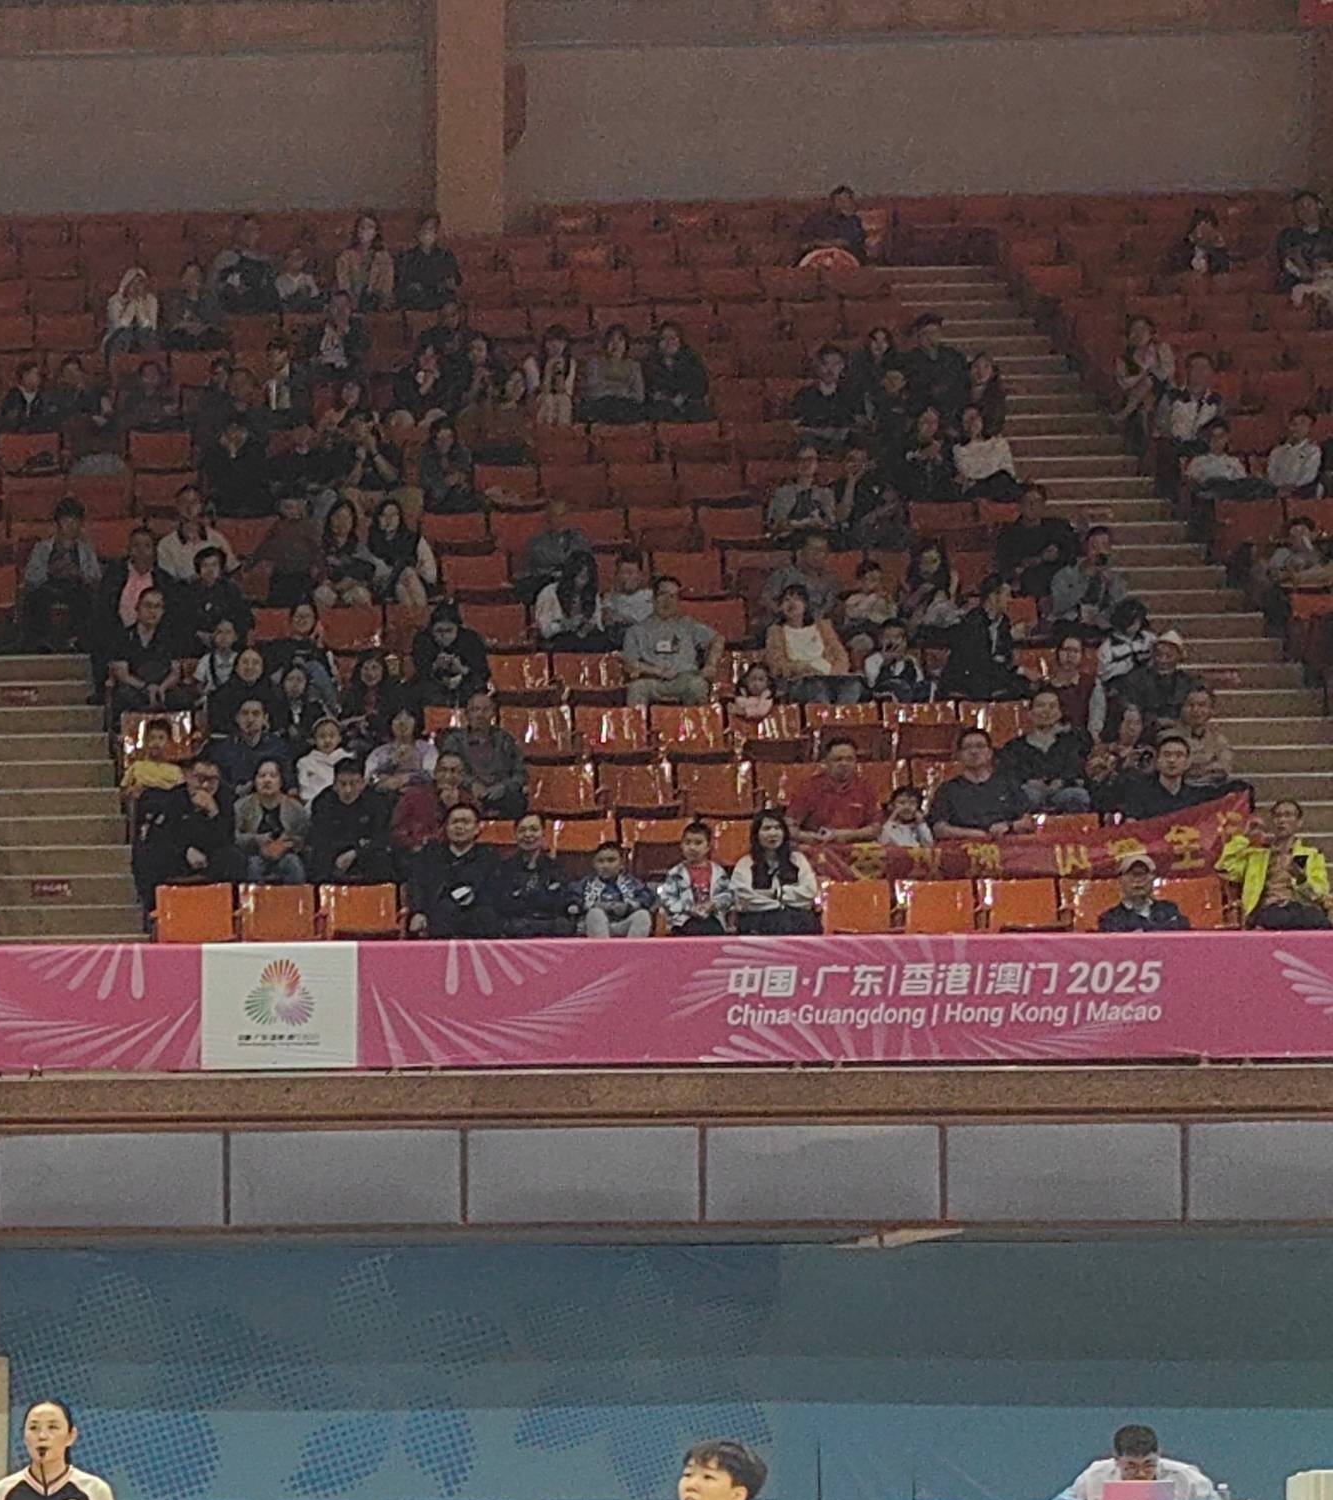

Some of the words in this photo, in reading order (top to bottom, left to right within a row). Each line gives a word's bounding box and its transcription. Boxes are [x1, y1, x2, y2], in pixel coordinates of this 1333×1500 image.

[1066, 960, 1163, 994] 2025
[944, 1002, 1003, 1027] Hong
[1010, 1001, 1068, 1027] Kong
[1086, 1001, 1162, 1022] Macao
